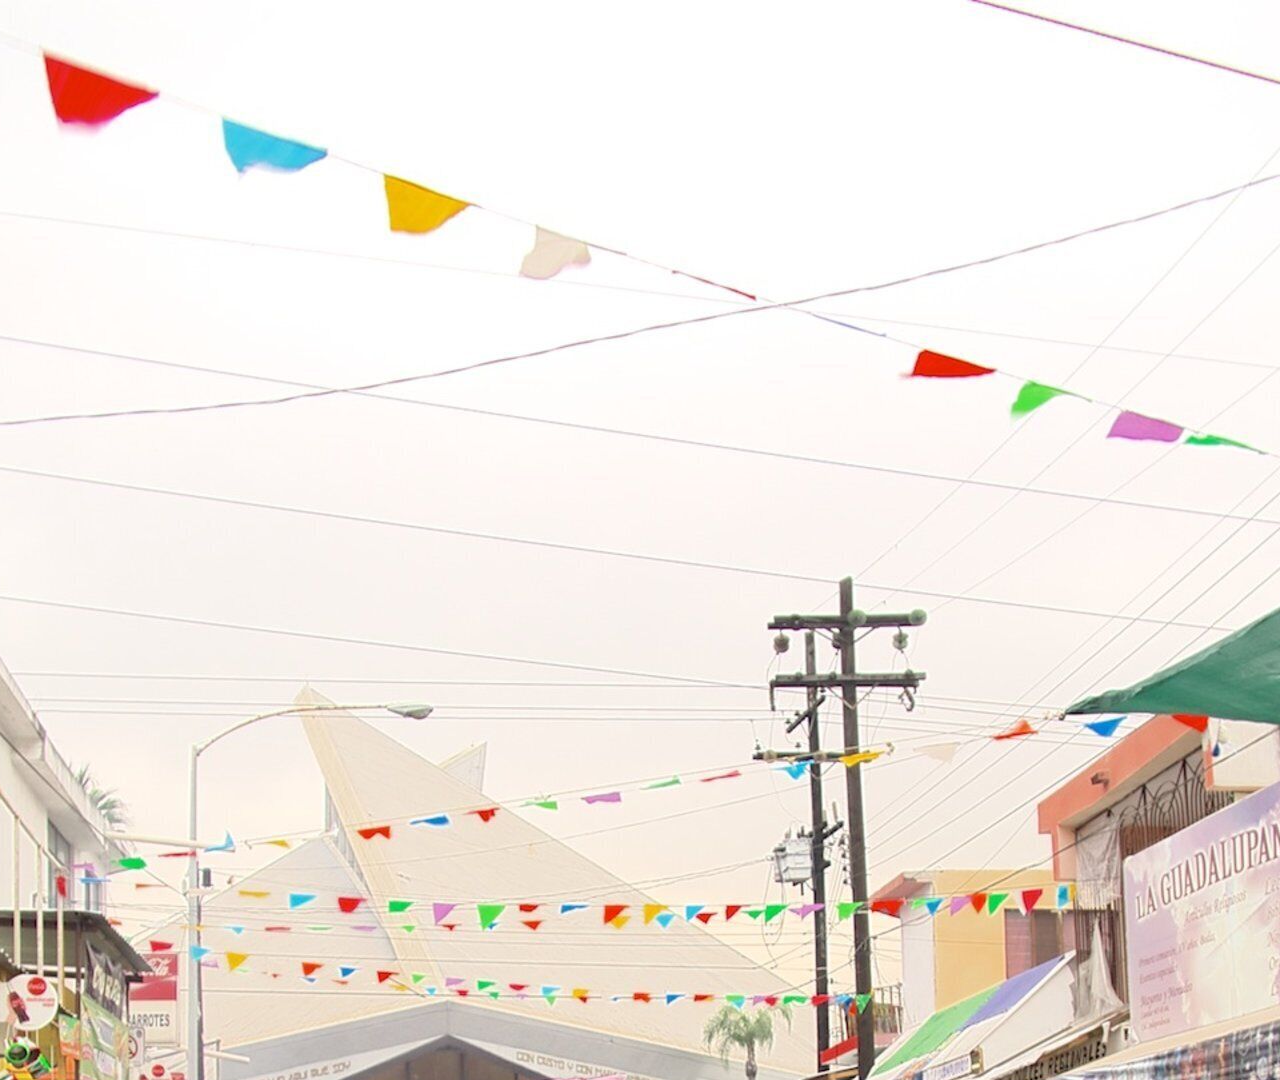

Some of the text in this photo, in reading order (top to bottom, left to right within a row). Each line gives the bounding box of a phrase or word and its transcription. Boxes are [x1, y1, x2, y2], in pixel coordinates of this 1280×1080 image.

[1136, 887, 1157, 920] LA
[130, 1013, 171, 1027] ARROTES
[1047, 1041, 1108, 1075] REGIONALES
